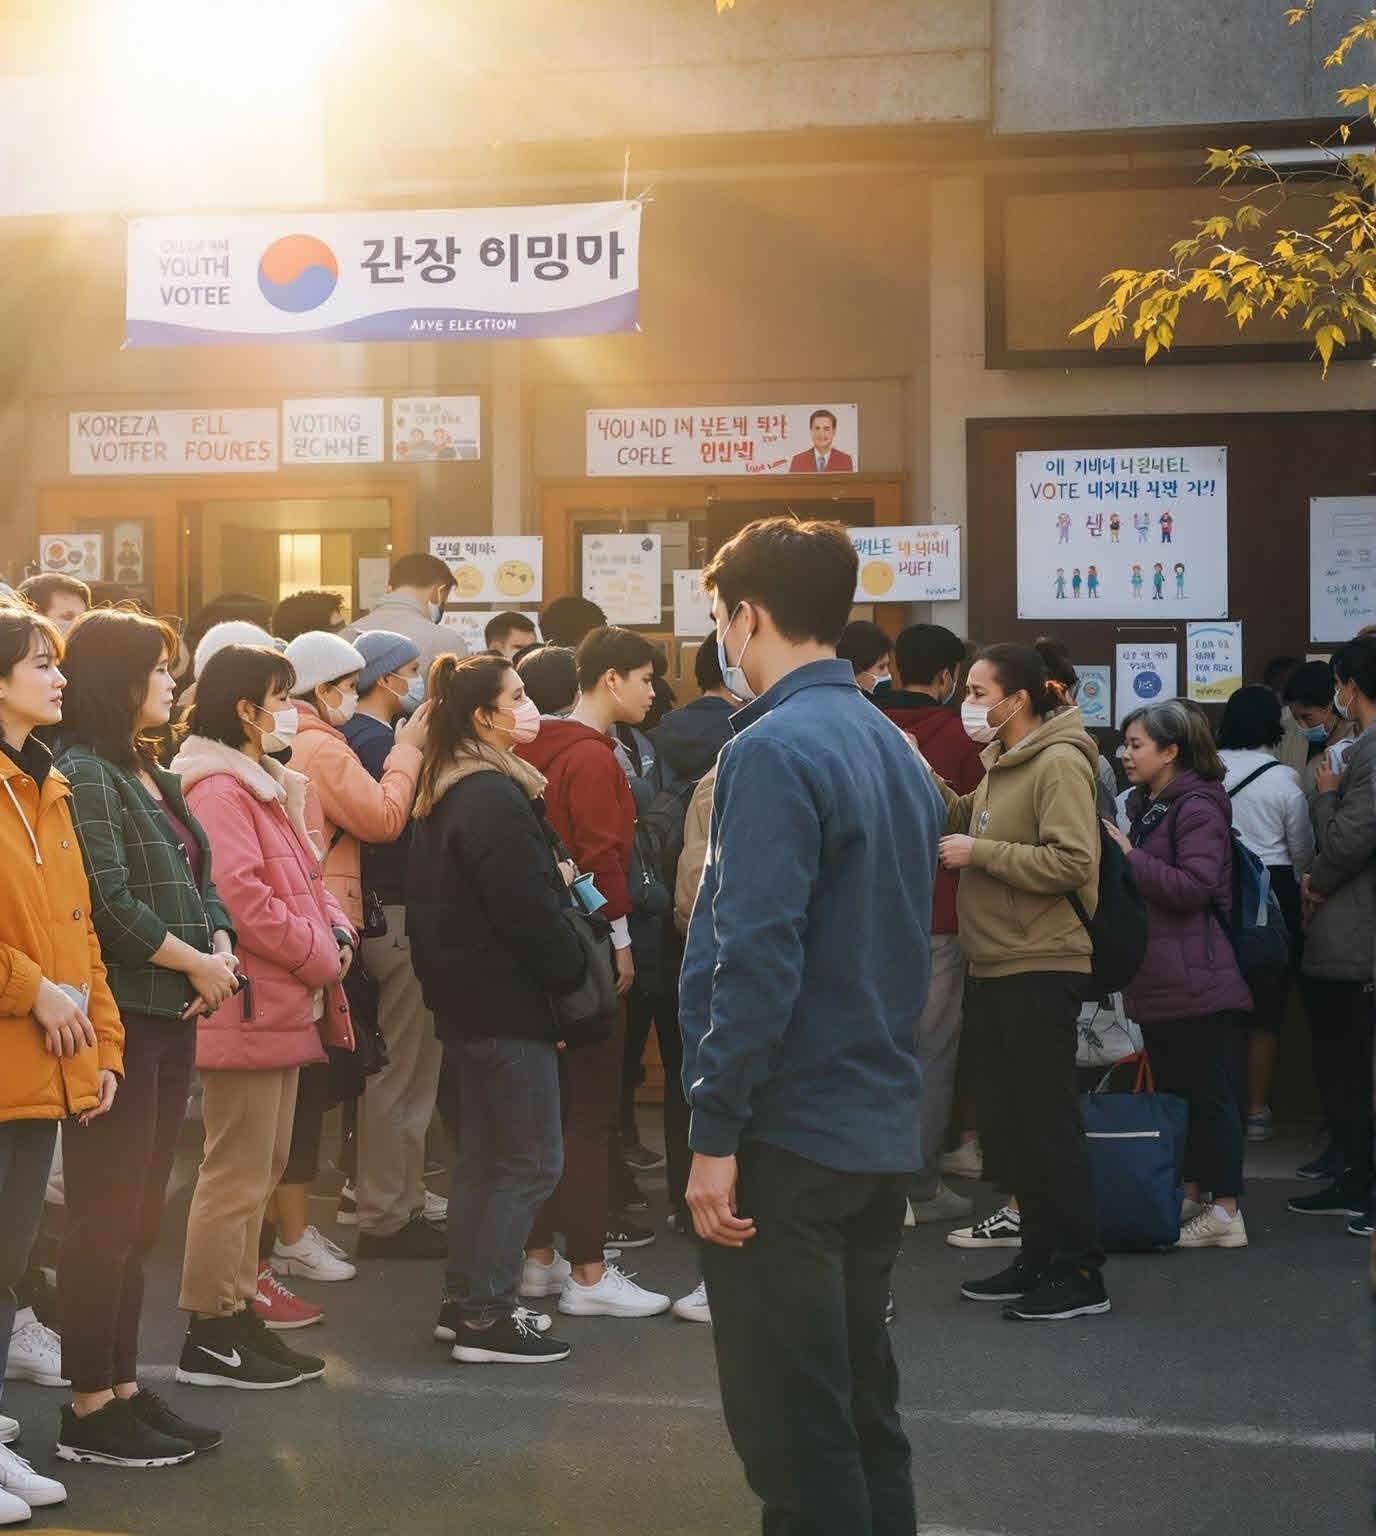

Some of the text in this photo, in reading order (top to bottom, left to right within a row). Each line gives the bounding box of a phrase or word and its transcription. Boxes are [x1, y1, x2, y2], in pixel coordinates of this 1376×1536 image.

[160, 286, 231, 306] VOTEE
[448, 318, 518, 332] ELECTION
[78, 415, 160, 438] KOREZA
[289, 413, 362, 433] VOTING
[598, 417, 634, 440] YOU
[1030, 481, 1081, 500] VOTE
